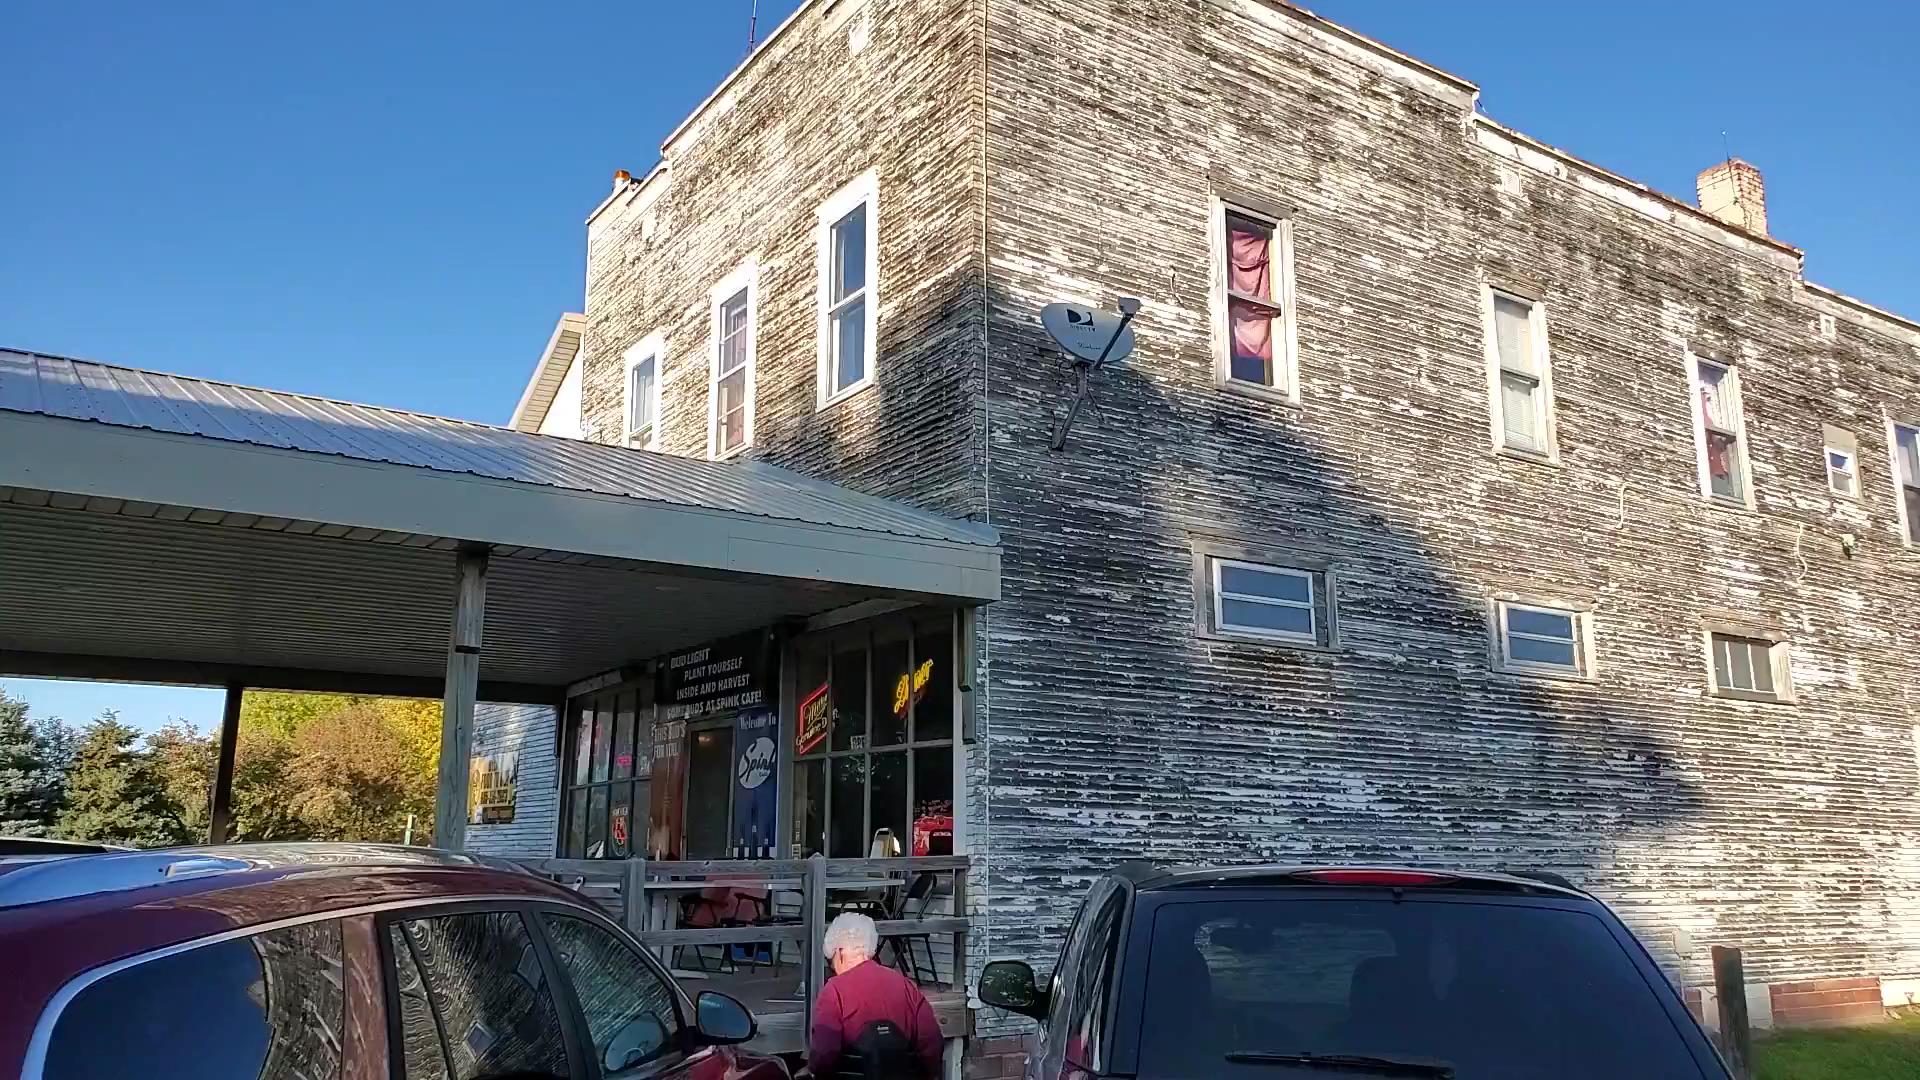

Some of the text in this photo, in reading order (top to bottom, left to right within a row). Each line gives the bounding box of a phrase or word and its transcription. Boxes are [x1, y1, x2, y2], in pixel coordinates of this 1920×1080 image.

[684, 656, 743, 681] PLANT YOURSELF
[687, 648, 711, 665] LIGHT
[676, 673, 750, 700] INSIDE AND HARVEST
[705, 700, 715, 713] AT
[716, 693, 740, 711] SPINK
[741, 689, 762, 705] CAFE!
